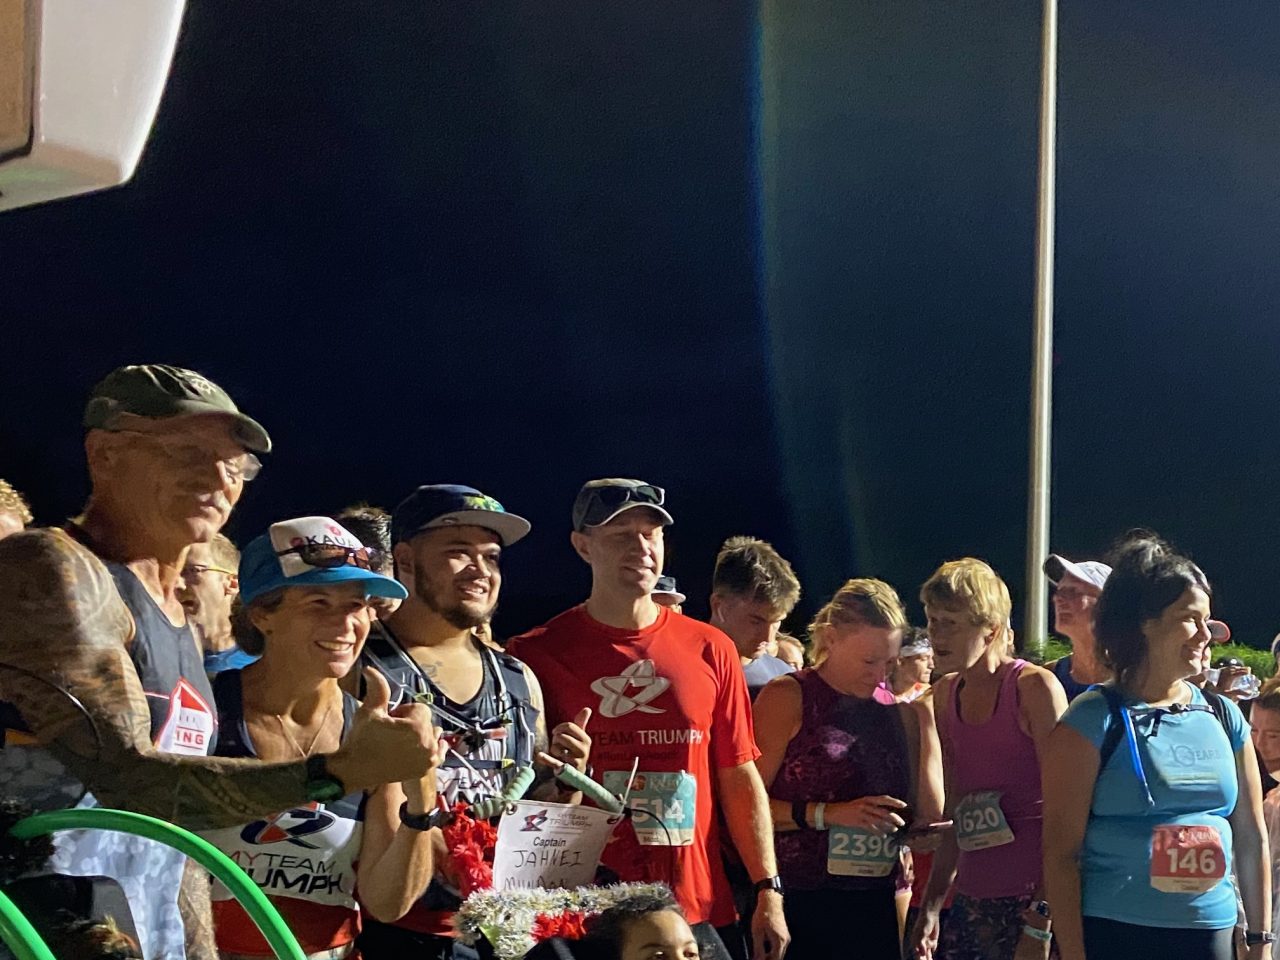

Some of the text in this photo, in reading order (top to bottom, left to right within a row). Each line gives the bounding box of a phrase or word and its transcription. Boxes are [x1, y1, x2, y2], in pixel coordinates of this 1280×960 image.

[636, 729, 704, 745] TRIUMPH
[533, 836, 567, 849] Captain
[1166, 847, 1217, 875] 146
